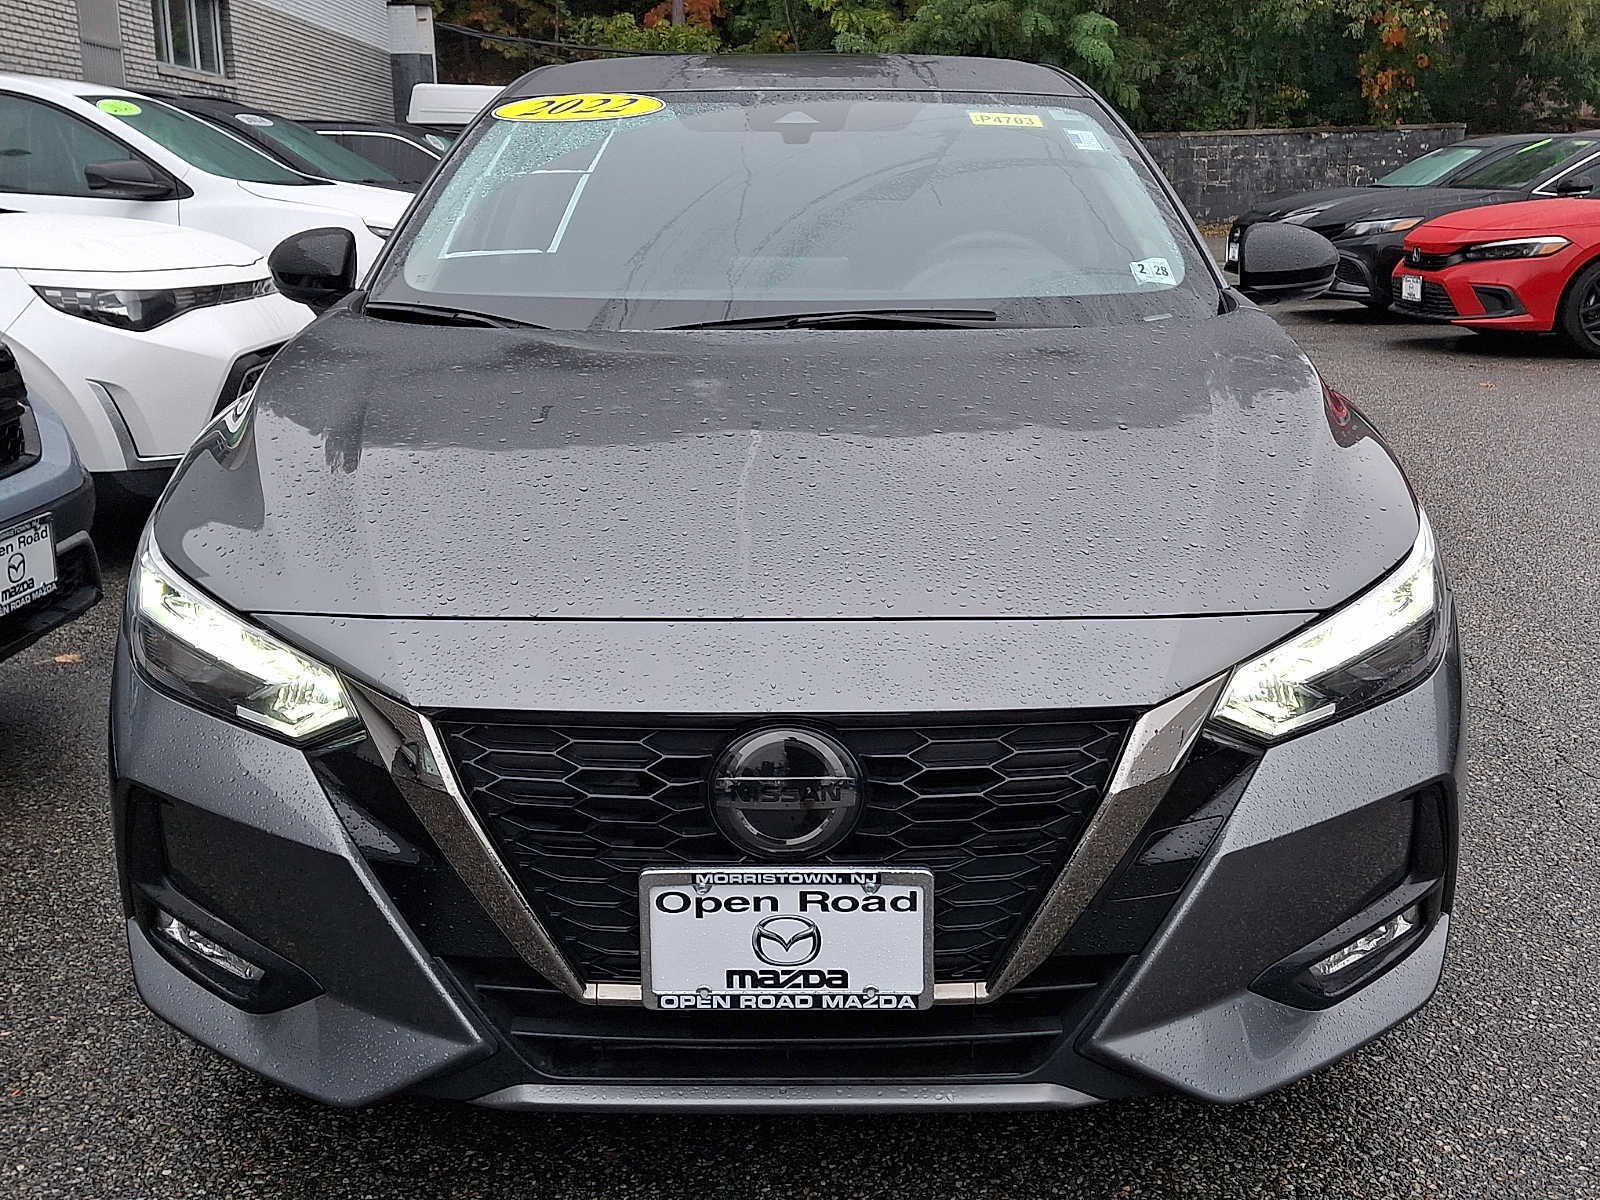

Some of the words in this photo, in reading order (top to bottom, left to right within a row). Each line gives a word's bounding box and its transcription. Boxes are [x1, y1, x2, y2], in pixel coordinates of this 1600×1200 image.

[517, 98, 639, 117] 2022
[18, 525, 48, 550] Road
[10, 595, 31, 612] ROAD
[851, 873, 877, 885] NJ
[655, 891, 779, 918] Open
[799, 890, 918, 913] Road
[660, 994, 729, 1009] OPEN
[740, 994, 812, 1009] ROAD
[823, 994, 916, 1009] MAZDA
